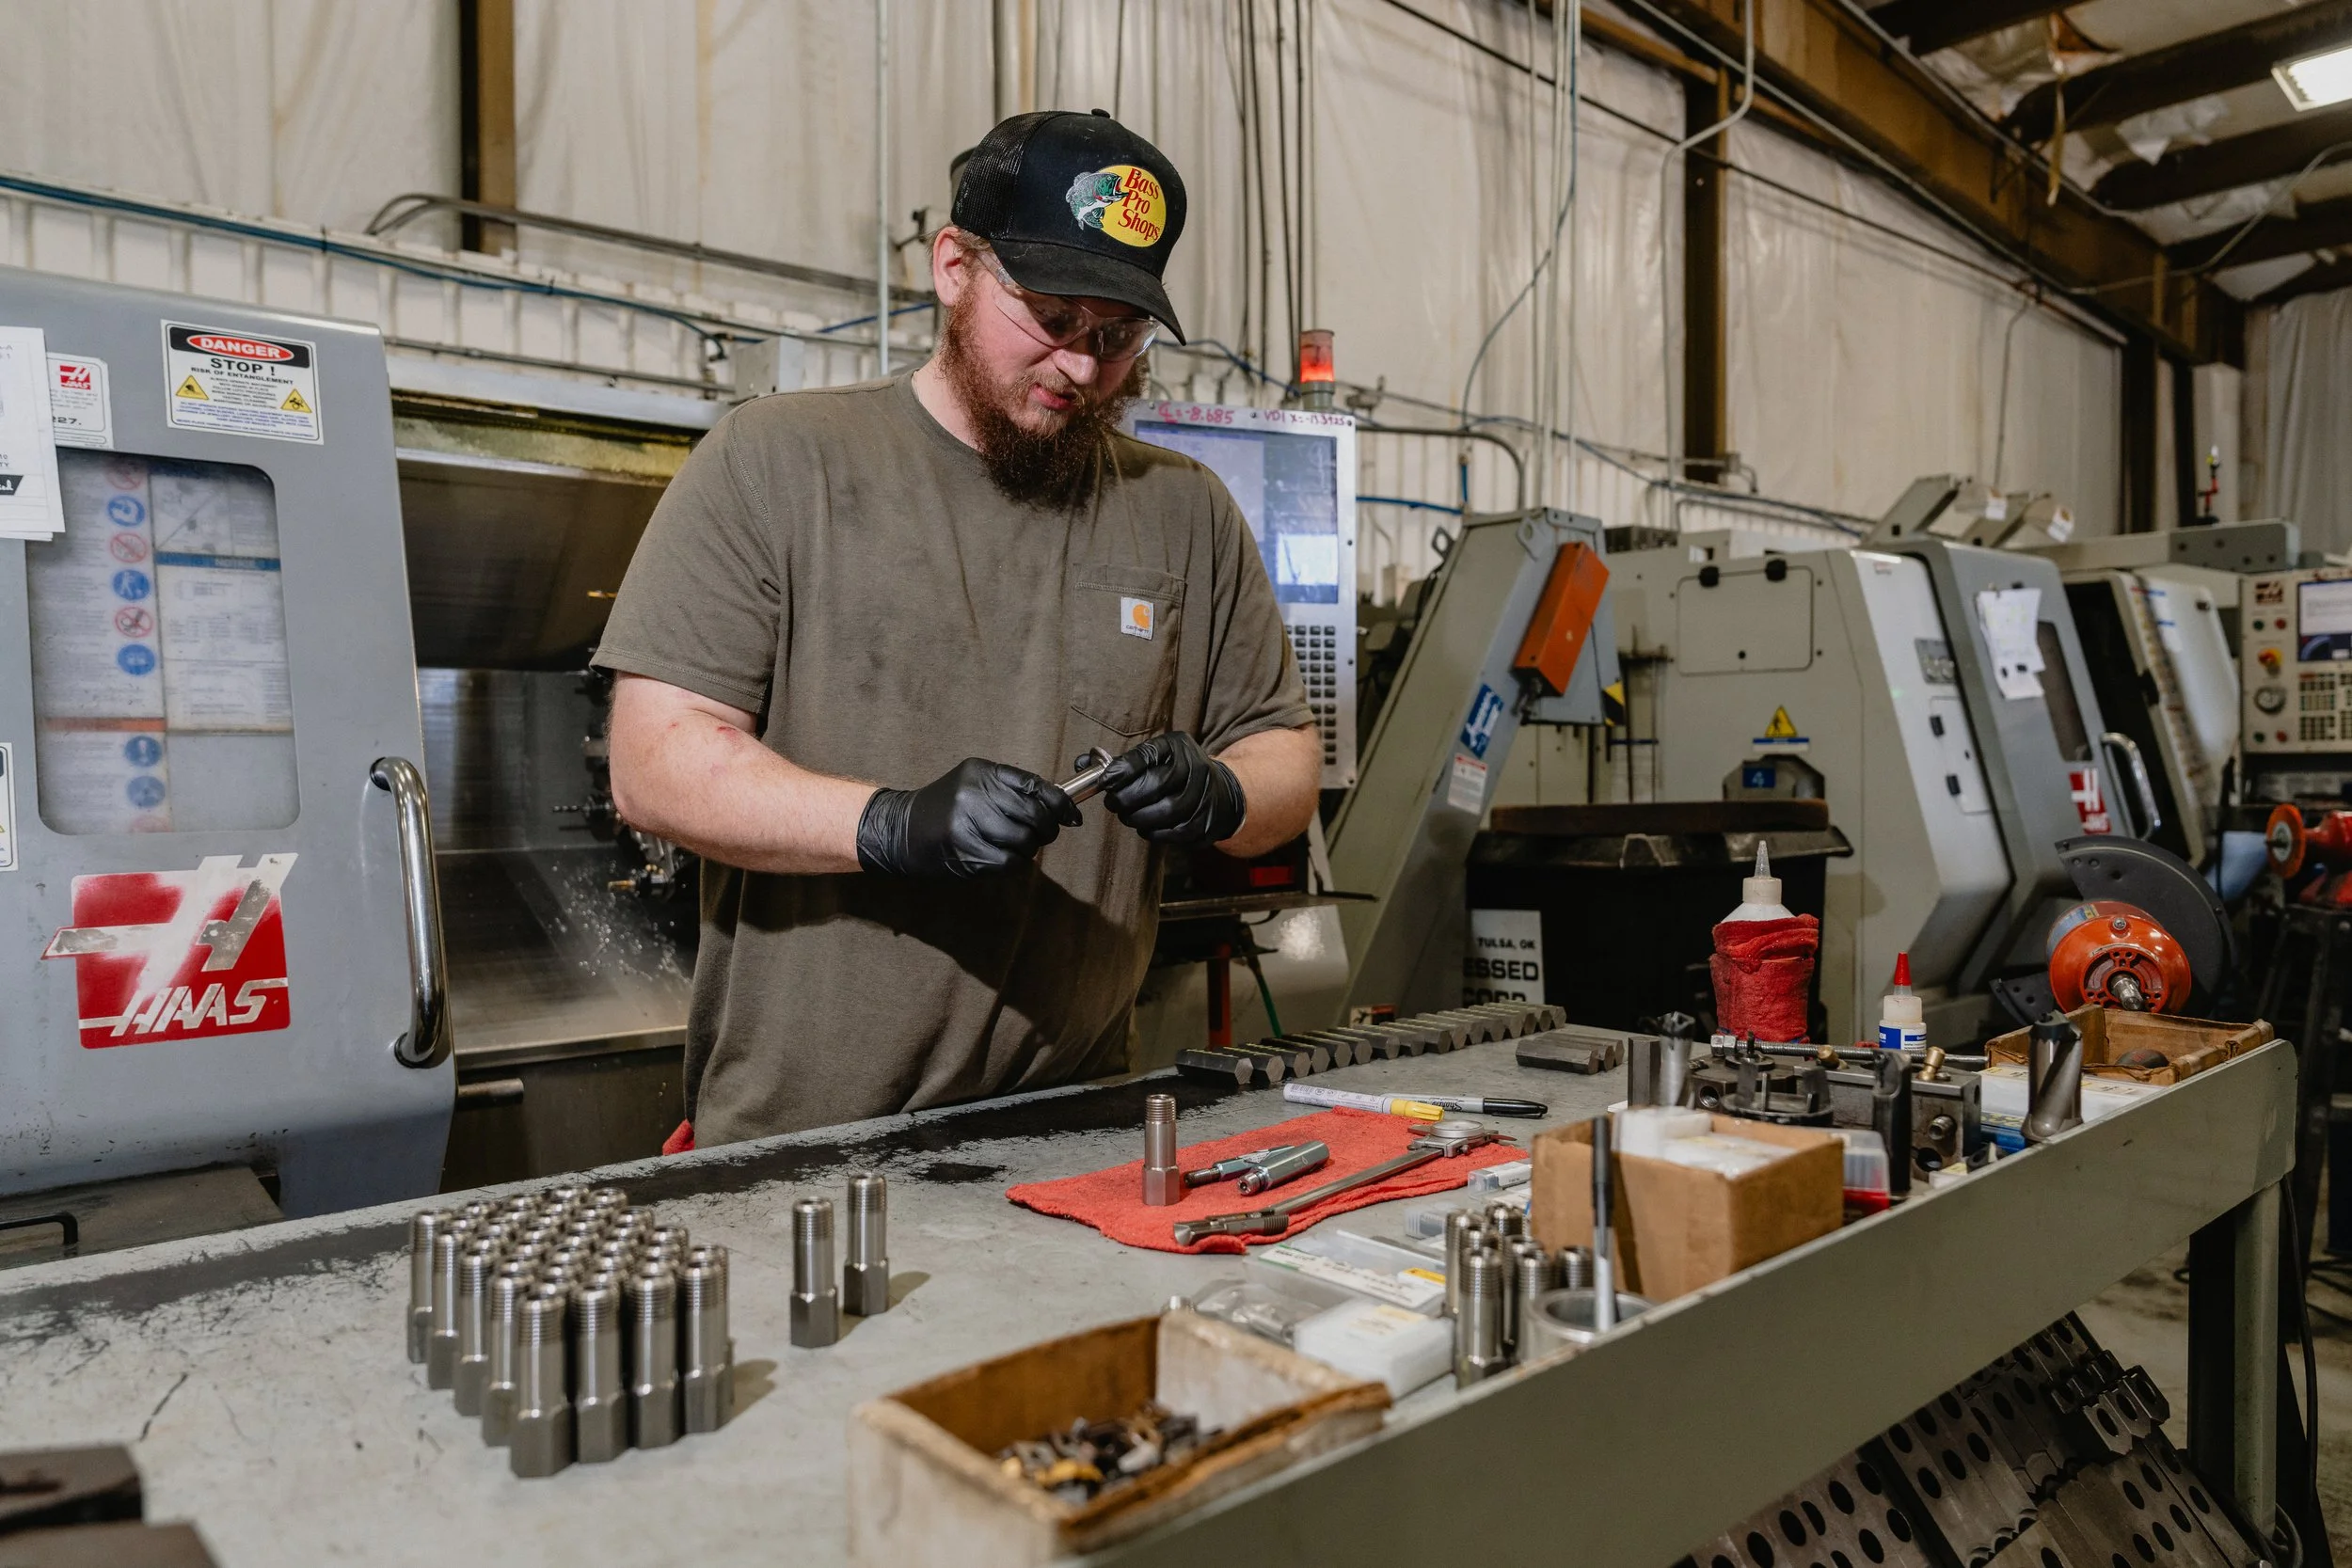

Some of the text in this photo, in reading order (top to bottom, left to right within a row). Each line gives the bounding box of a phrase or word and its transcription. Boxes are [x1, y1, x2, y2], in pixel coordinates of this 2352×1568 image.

[1123, 167, 1160, 200] Bass
[1121, 188, 1151, 214] Pro
[1118, 208, 1161, 242] Shops
[199, 337, 281, 358] DANGER
[190, 366, 212, 374] RISK
[227, 371, 294, 385] ENTANGLEMENT
[210, 357, 263, 373] STOP
[79, 978, 289, 1037] HAAS
